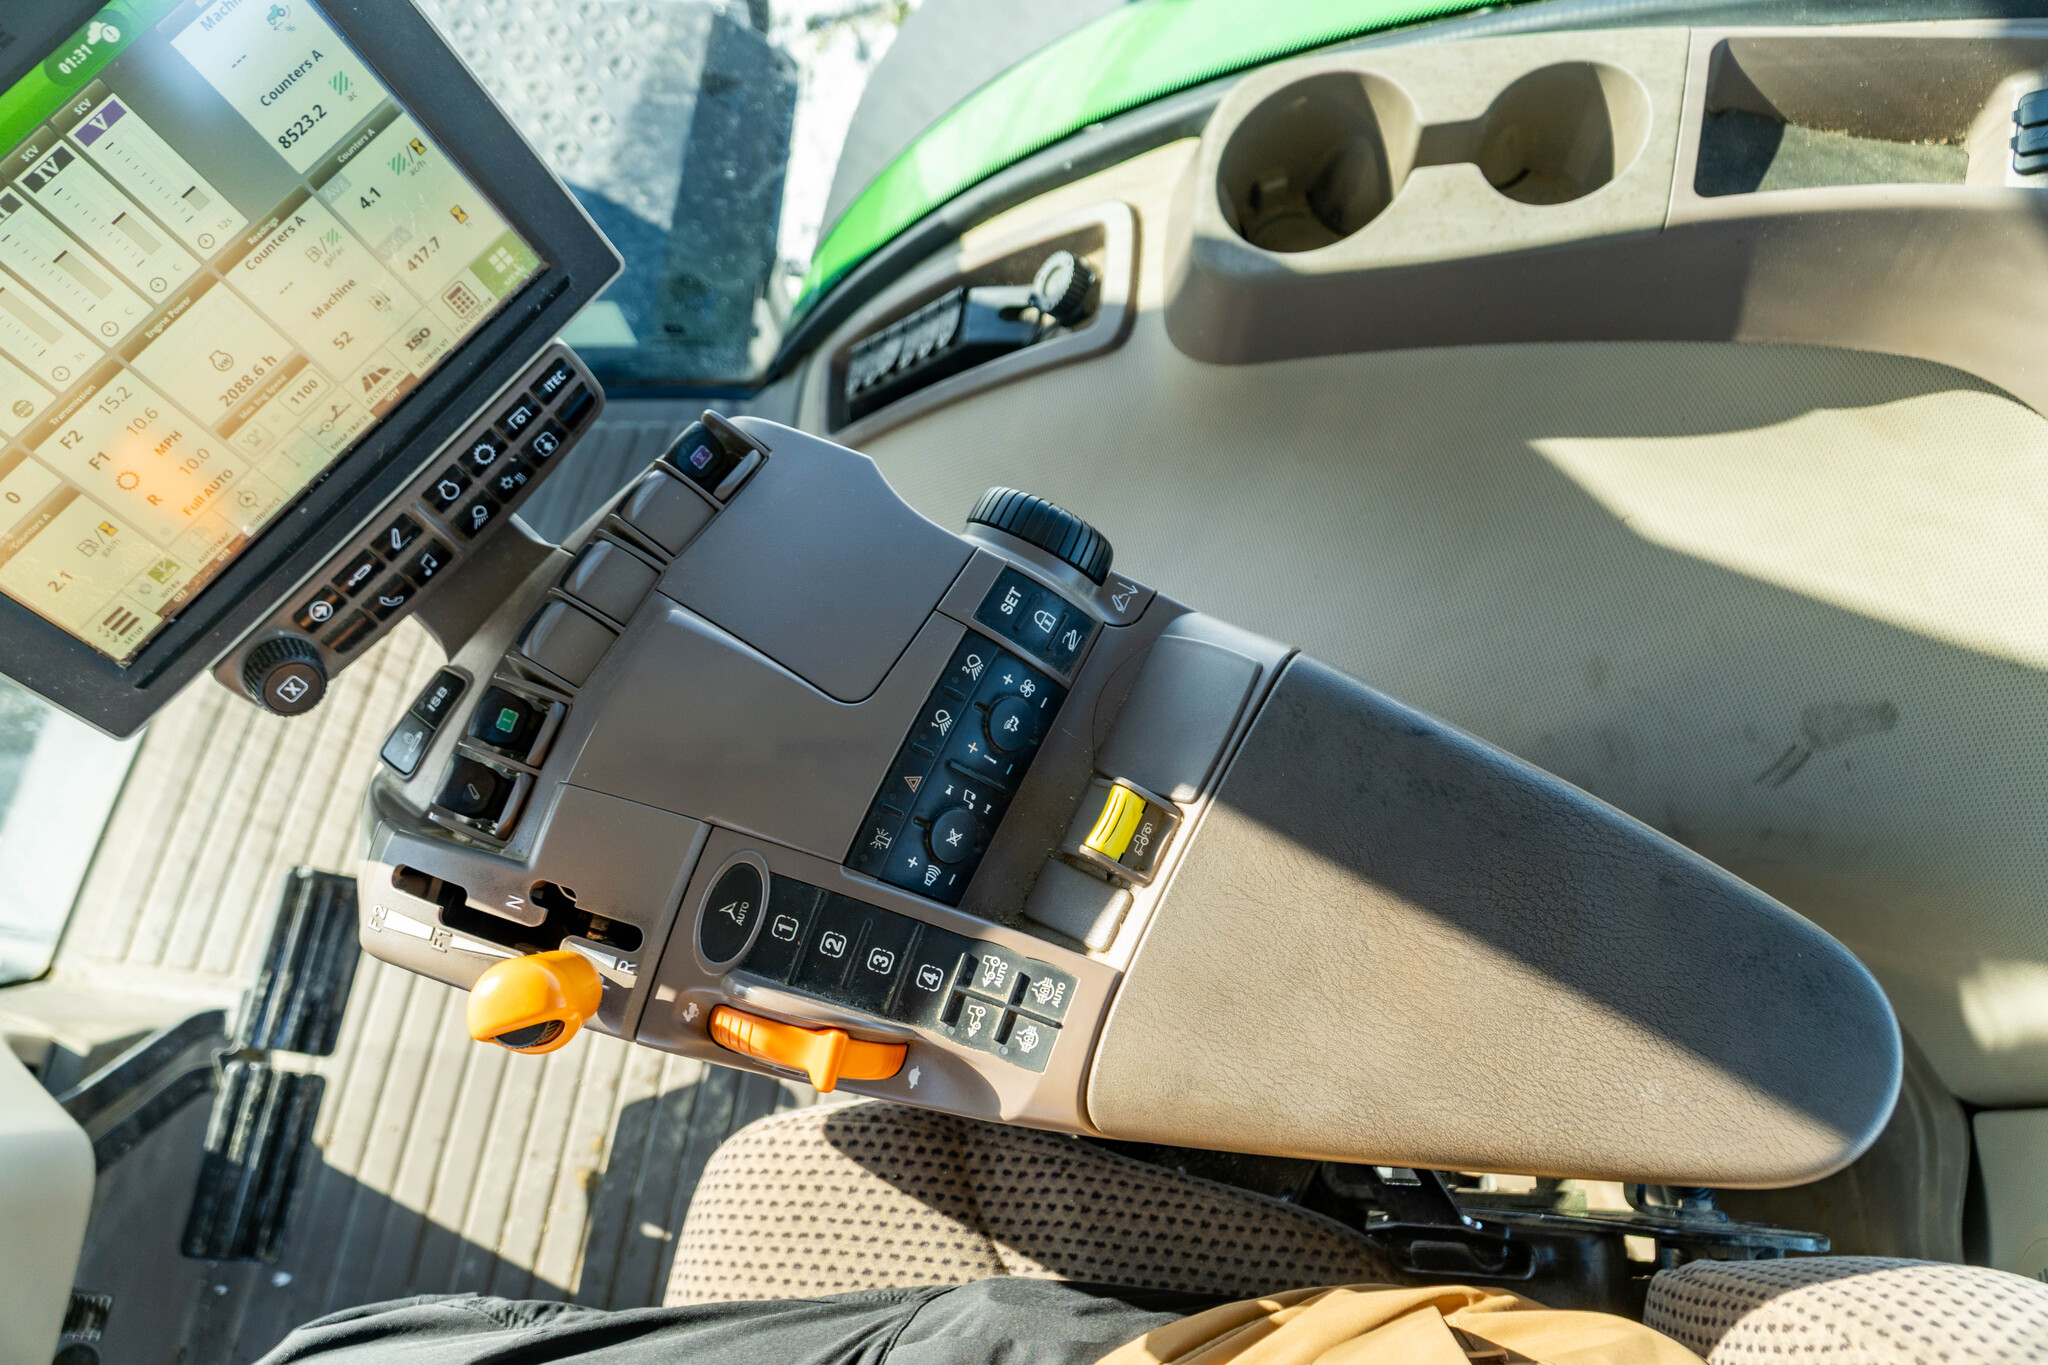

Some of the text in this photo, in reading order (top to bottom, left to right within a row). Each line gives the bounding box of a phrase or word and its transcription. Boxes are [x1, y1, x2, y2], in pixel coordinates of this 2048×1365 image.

[58, 44, 93, 74] 01:31
[260, 49, 324, 107] Counters A
[73, 98, 92, 115] SCV
[89, 112, 108, 131] V
[278, 104, 327, 149] 8523.2
[20, 144, 39, 162] SCV
[337, 128, 376, 163] Counters A
[32, 156, 60, 183] IV
[360, 187, 381, 209] 4.1
[245, 216, 306, 271] Counters A
[407, 236, 439, 272] 417.7
[311, 279, 357, 319] Machine
[145, 296, 192, 340] Engine Power
[332, 331, 354, 350] 52
[405, 327, 432, 352] ISO
[219, 354, 278, 407] 2088.6 h
[290, 379, 319, 405] 1100
[543, 370, 567, 393] iTEC
[48, 384, 97, 426] Transmission
[98, 386, 133, 415] 15.2
[126, 407, 159, 436] 10.6
[59, 430, 84, 450] F2
[154, 430, 183, 457] MPH
[88, 451, 112, 471] F1
[179, 448, 210, 476] 10.0
[146, 493, 163, 506] R
[182, 469, 234, 516] Full AUTO
[47, 571, 73, 593] 2.1
[1001, 586, 1022, 615] SET
[427, 686, 448, 712] ISB
[506, 894, 525, 910] N
[735, 901, 750, 926] AUTO
[367, 903, 388, 933] F2
[778, 922, 794, 932] 1
[430, 927, 453, 954] F1
[825, 937, 842, 953] 2
[616, 960, 637, 976] R
[872, 954, 890, 968] 3
[921, 971, 939, 985] 4
[994, 962, 1008, 988] AUTO
[1051, 981, 1066, 1009] AUTO
